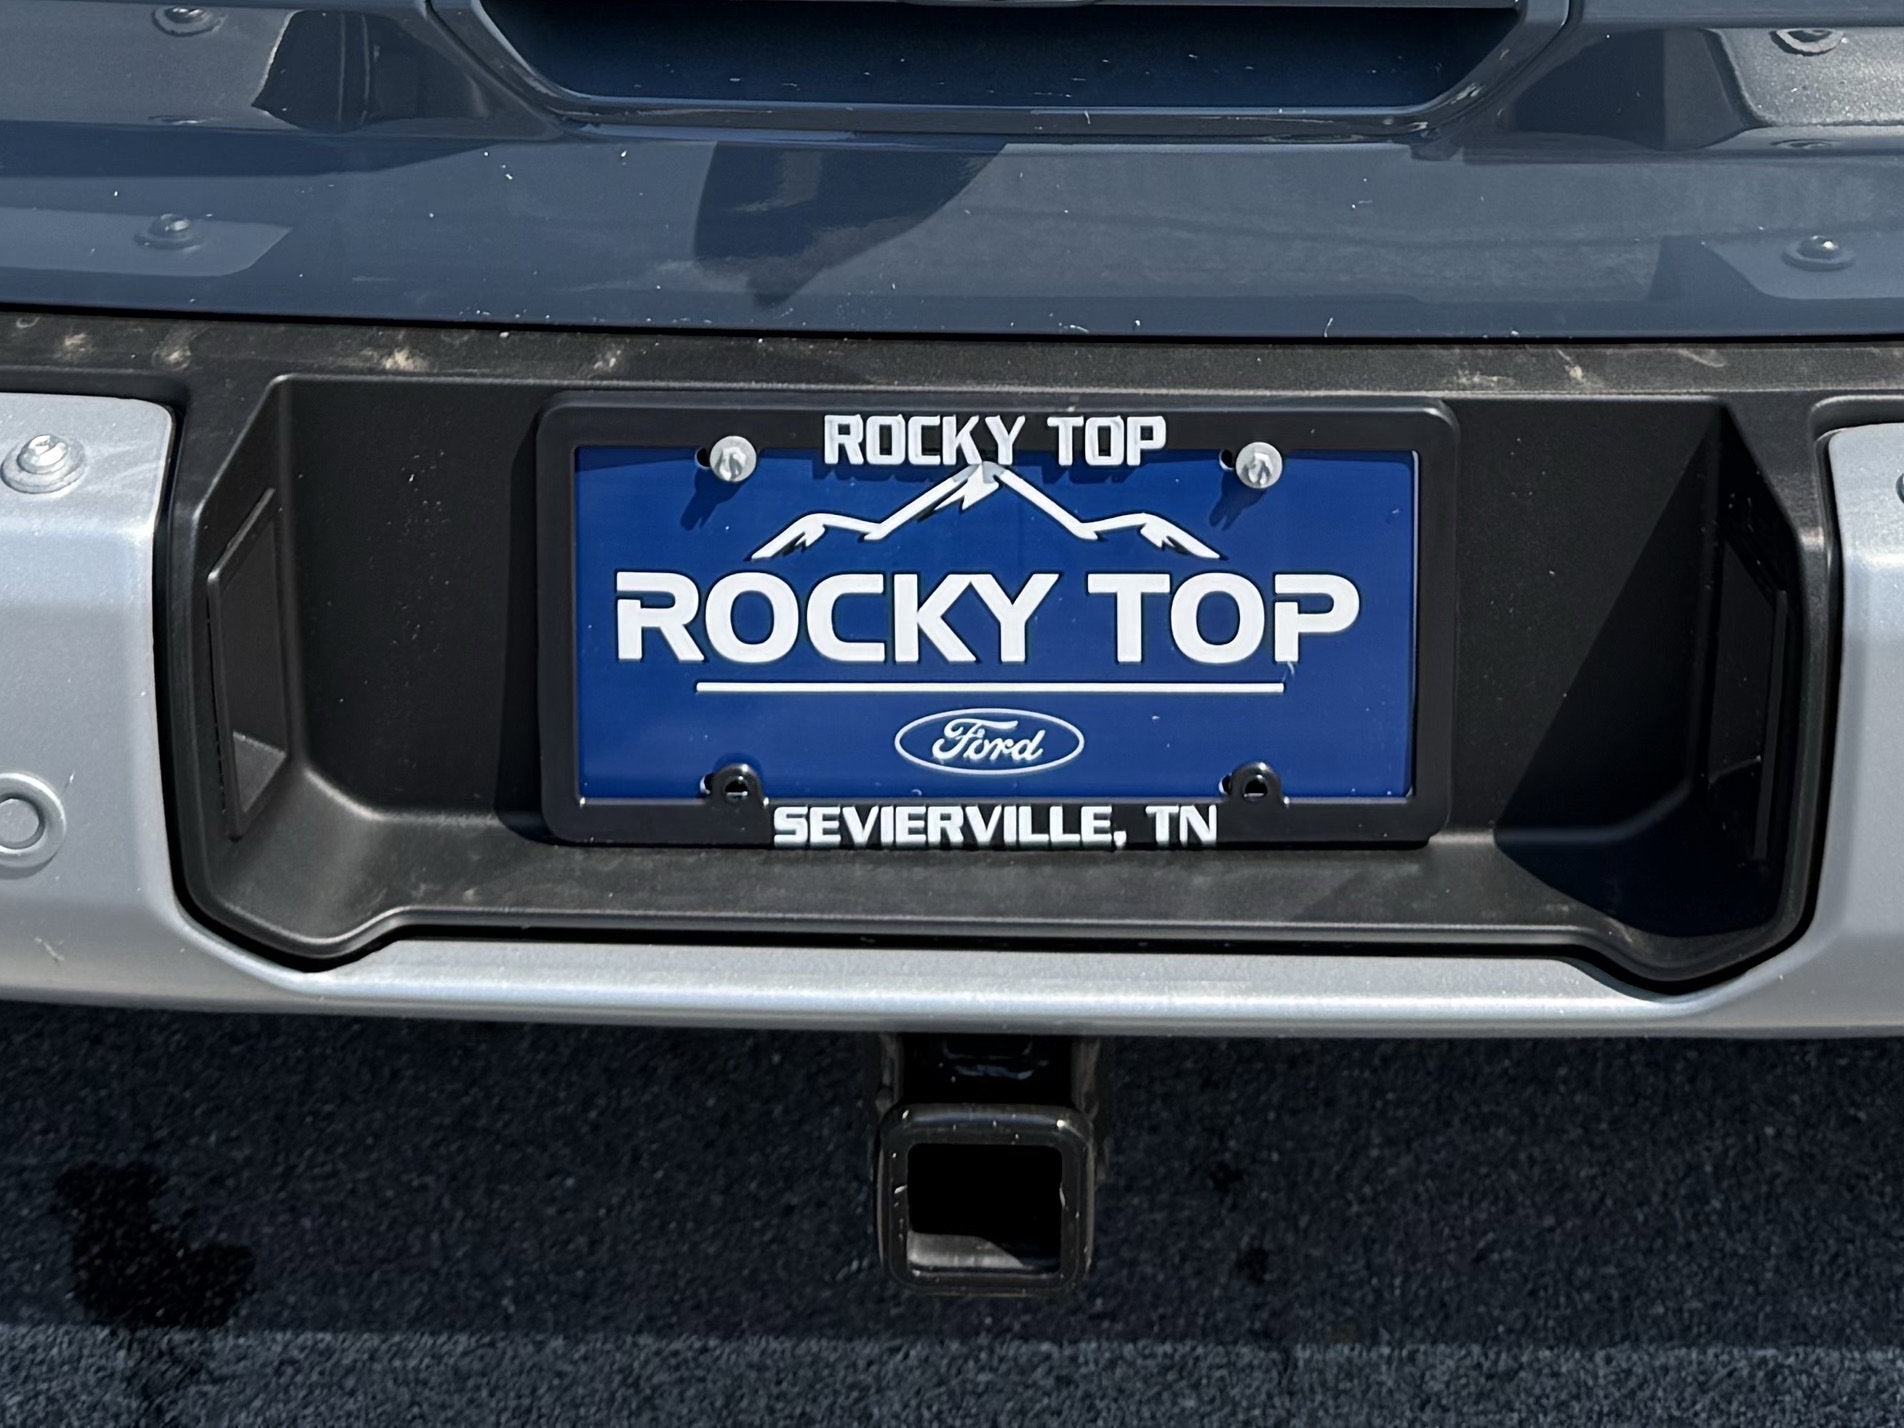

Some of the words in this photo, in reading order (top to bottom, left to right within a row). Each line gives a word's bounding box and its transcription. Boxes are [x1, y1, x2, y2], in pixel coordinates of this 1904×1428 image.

[823, 413, 1026, 466] ROCKY
[1047, 414, 1167, 467] TOP
[615, 571, 1061, 664] ROCKY
[1086, 572, 1361, 664] TOP
[931, 717, 1044, 763] Ford
[773, 804, 1128, 850] SEVIERVILLE,
[1145, 804, 1218, 846] TN
